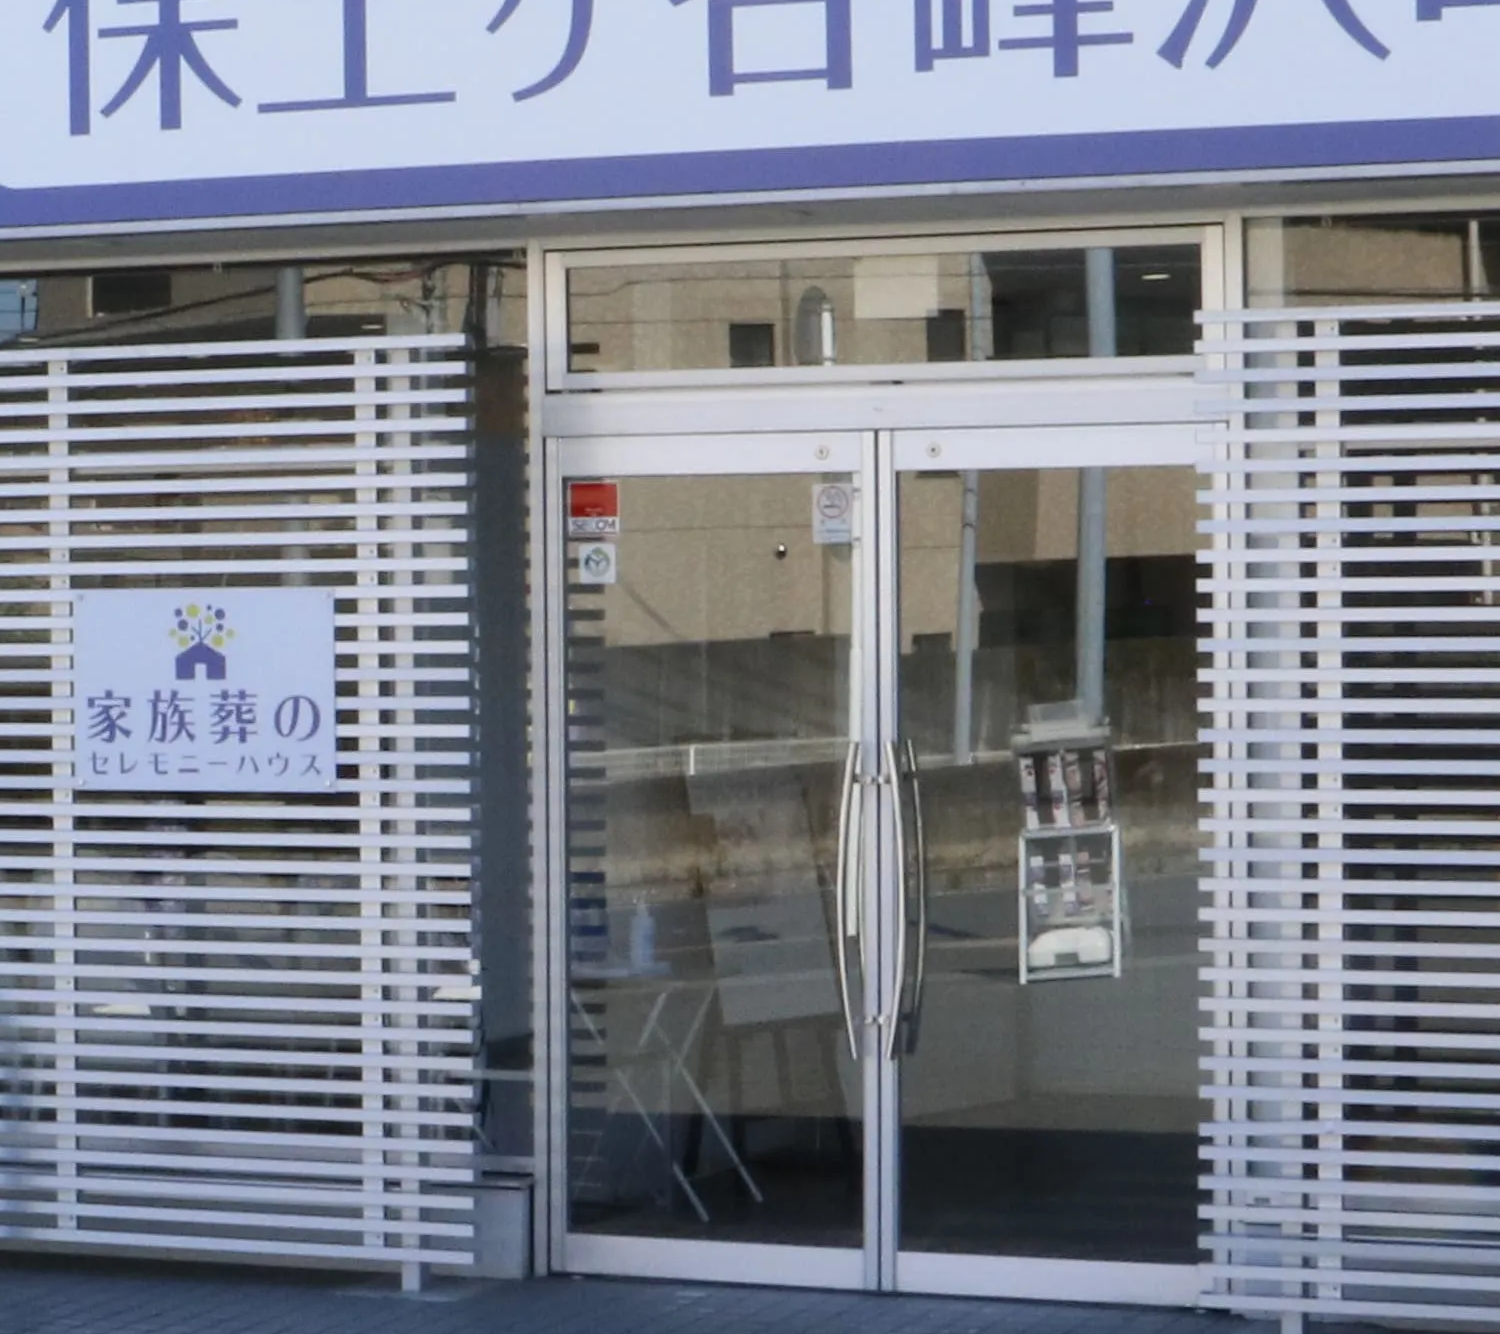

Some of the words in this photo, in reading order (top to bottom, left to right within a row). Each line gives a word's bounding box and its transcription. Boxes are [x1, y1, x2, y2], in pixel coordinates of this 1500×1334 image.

[87, 689, 321, 744] 家族葬の
[89, 751, 323, 778] セレモニーハウス
